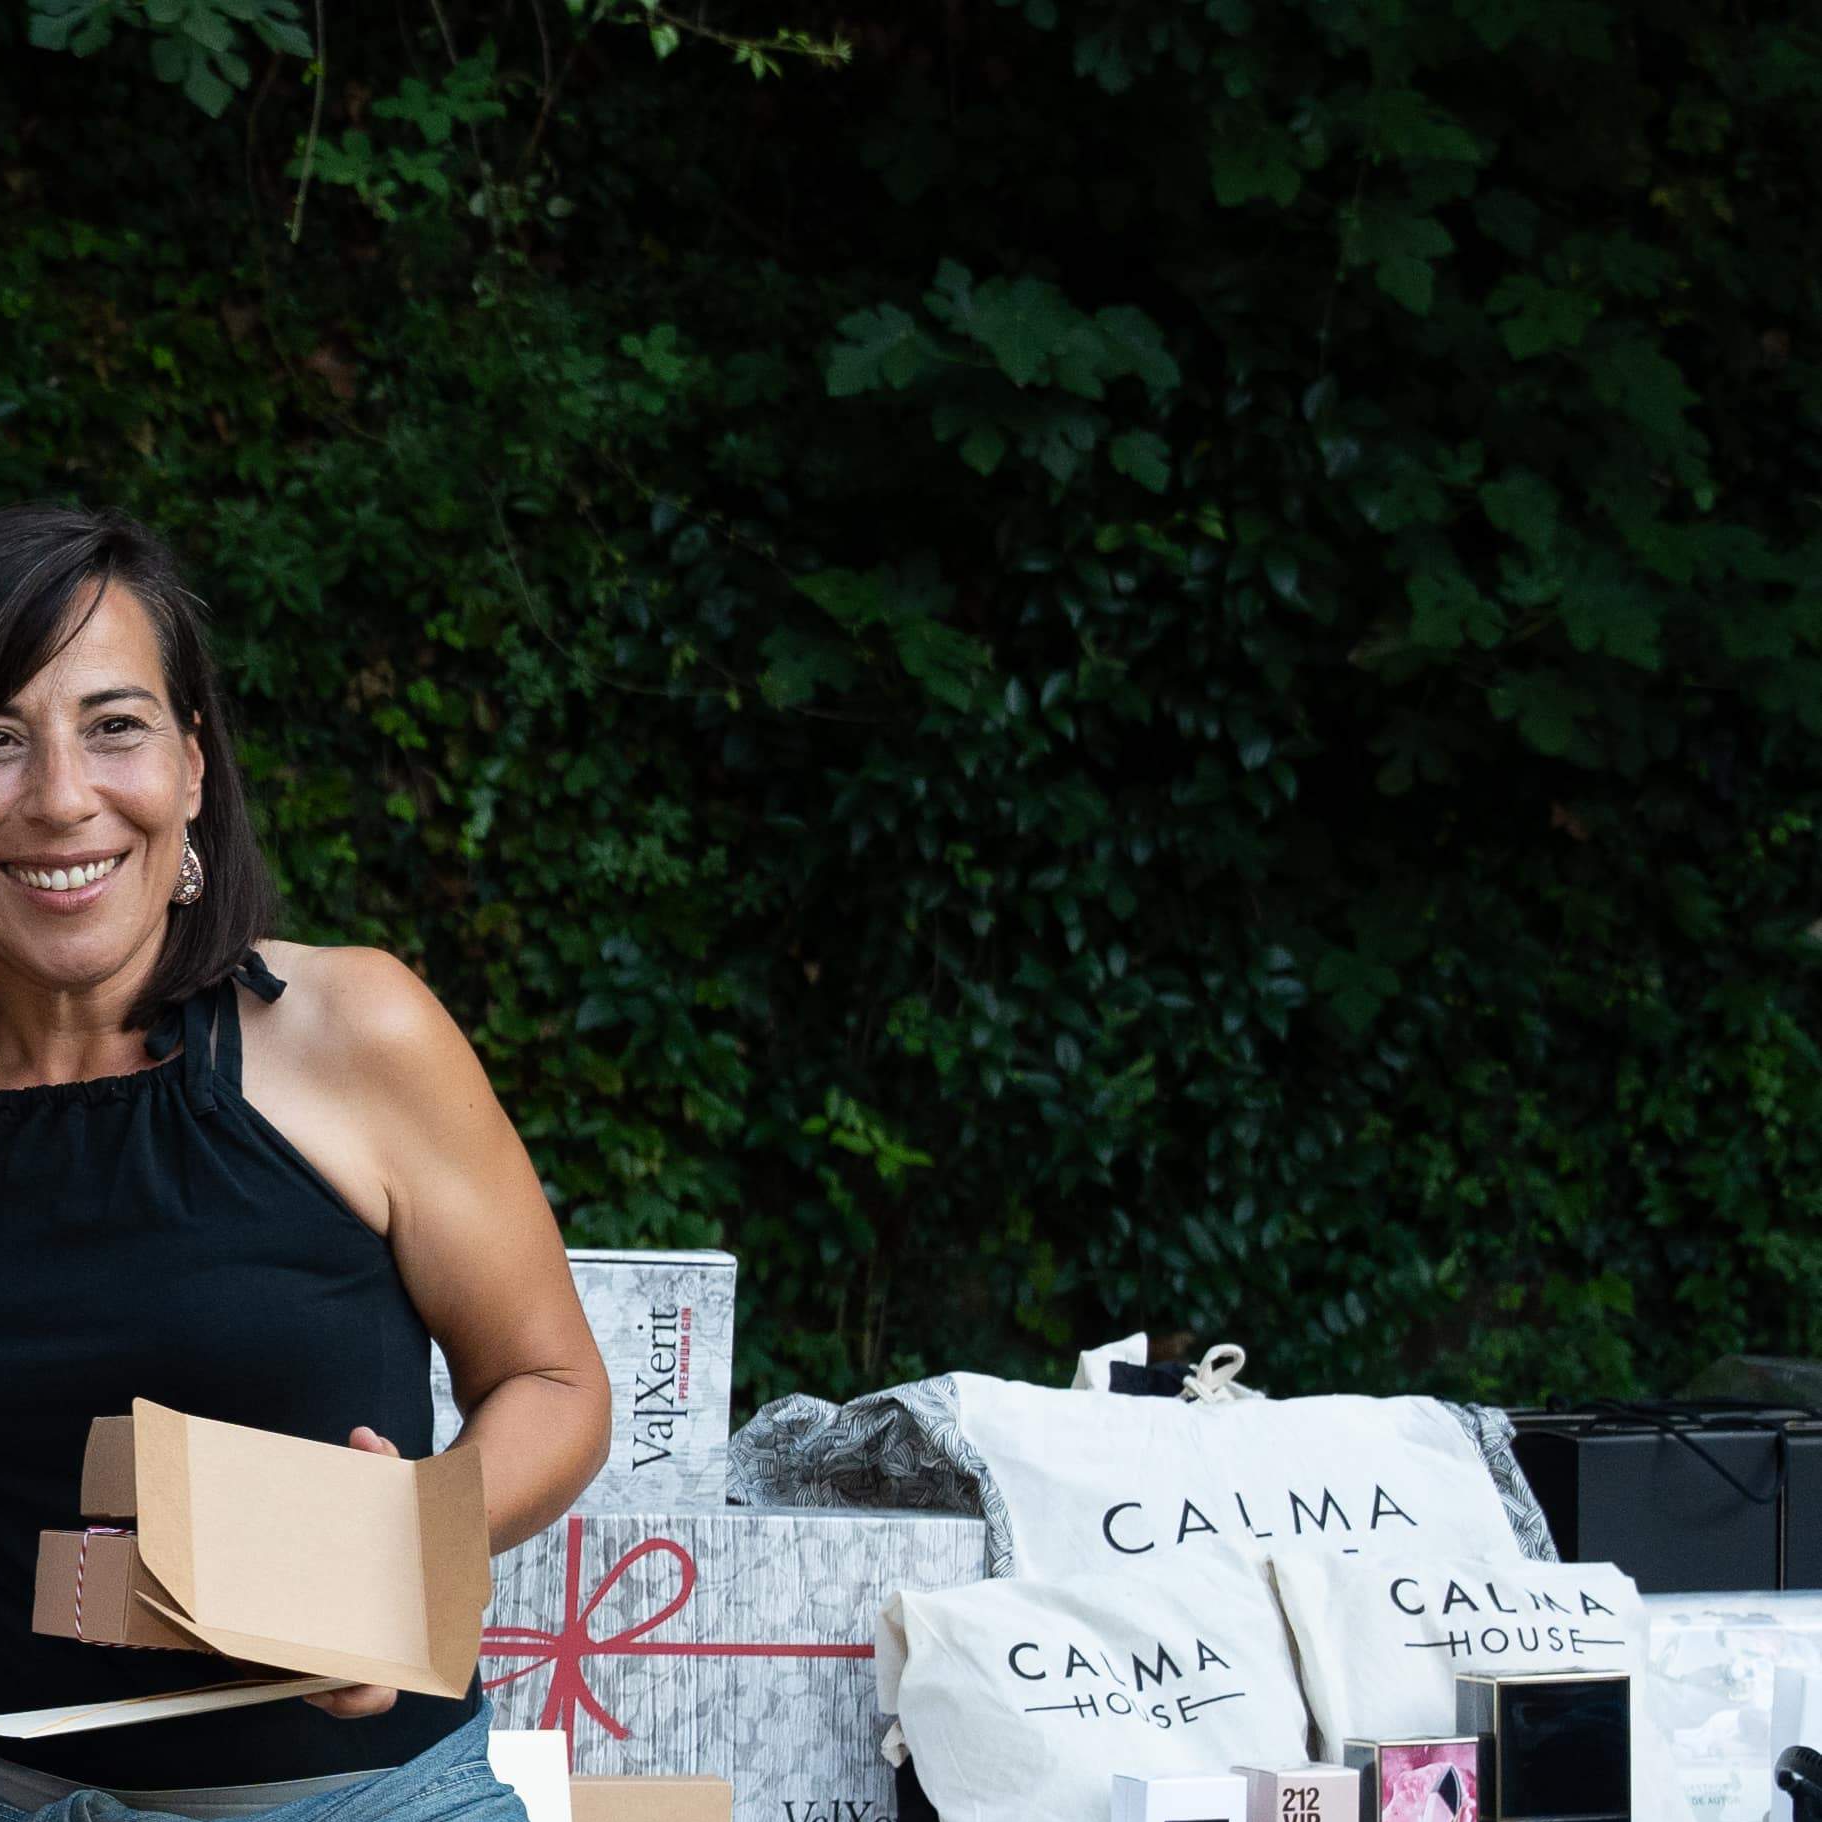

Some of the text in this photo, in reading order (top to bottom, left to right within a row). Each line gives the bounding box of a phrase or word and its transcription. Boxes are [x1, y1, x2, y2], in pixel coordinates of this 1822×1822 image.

[678, 1307, 693, 1401] PREMIUM GIN
[632, 1304, 688, 1473] ValXerit
[1102, 1484, 1418, 1555] CALMA
[1390, 1577, 1616, 1617] CALMA
[1008, 1639, 1231, 1692] CALMA
[1449, 1626, 1586, 1658] HOUSE
[1282, 1787, 1320, 1812] 212
